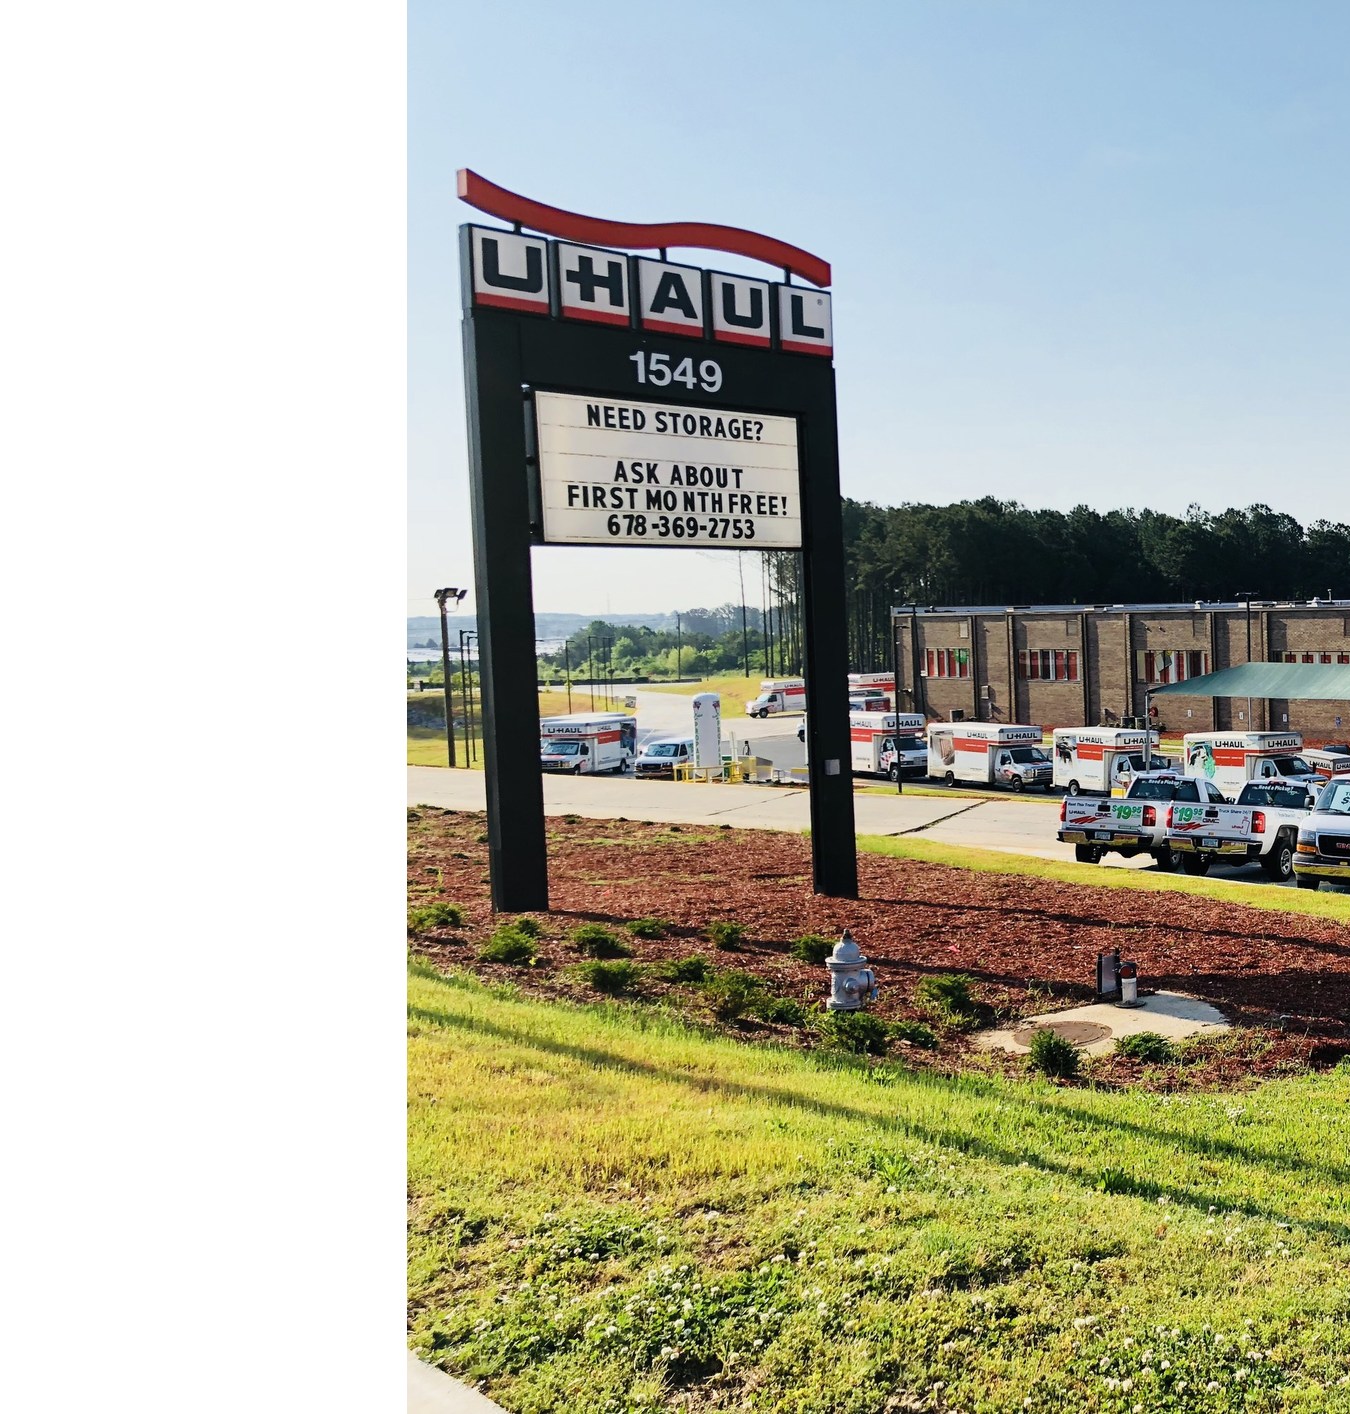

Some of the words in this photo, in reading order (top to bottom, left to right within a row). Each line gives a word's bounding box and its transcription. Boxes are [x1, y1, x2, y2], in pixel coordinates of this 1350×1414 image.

[629, 350, 723, 393] 1549
[586, 404, 646, 431] NEED
[655, 410, 764, 442] STORAGE?
[614, 460, 659, 486] ASK
[670, 463, 743, 491] ABOUT
[567, 484, 638, 511] FIRST
[728, 492, 788, 517] FREE!
[607, 513, 756, 541] 678-369-2753
[1006, 732, 1038, 740] U-HAUL
[1079, 736, 1104, 744] U-HAUL
[1215, 740, 1245, 749] U-HAUL
[1267, 739, 1299, 748] U-HAUL
